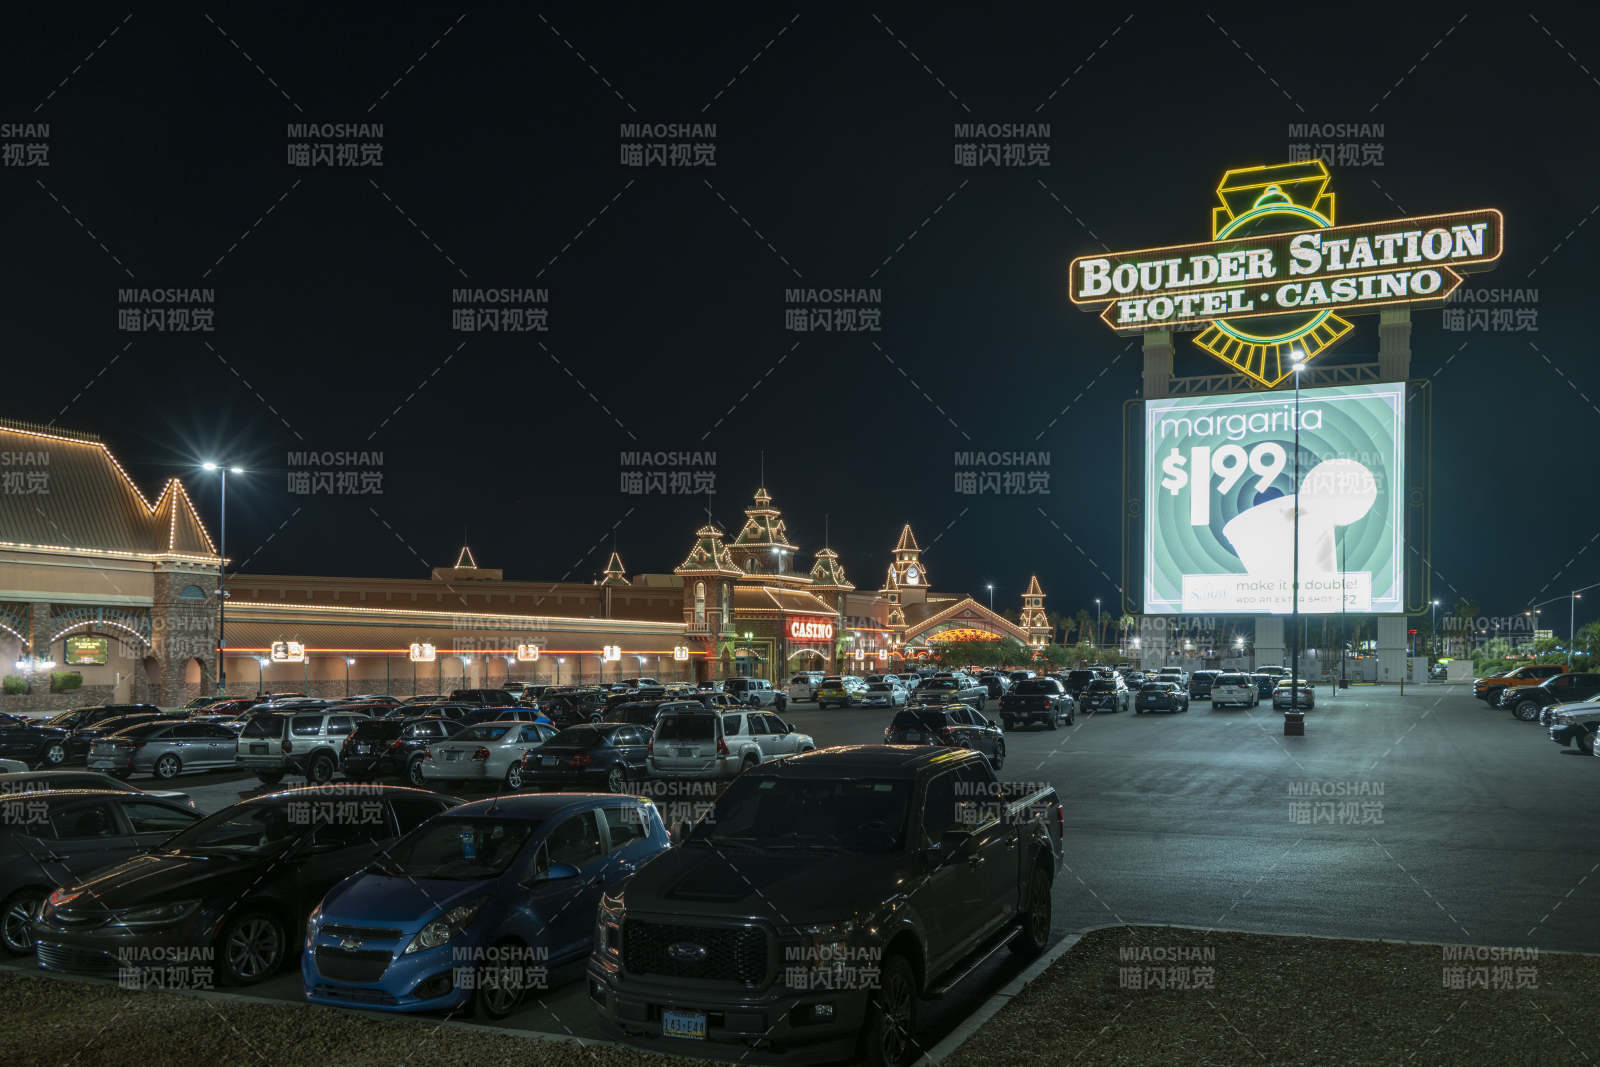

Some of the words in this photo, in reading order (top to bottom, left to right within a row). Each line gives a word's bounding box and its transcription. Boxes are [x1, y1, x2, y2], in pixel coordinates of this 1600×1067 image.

[1079, 249, 1277, 297] BOULDER
[1289, 223, 1487, 275] STATION
[1117, 289, 1254, 324] HOTEL
[1276, 269, 1442, 308] CASINO
[1161, 405, 1322, 441] margarita
[1236, 579, 1275, 592] make
[791, 621, 833, 639] CASINO
